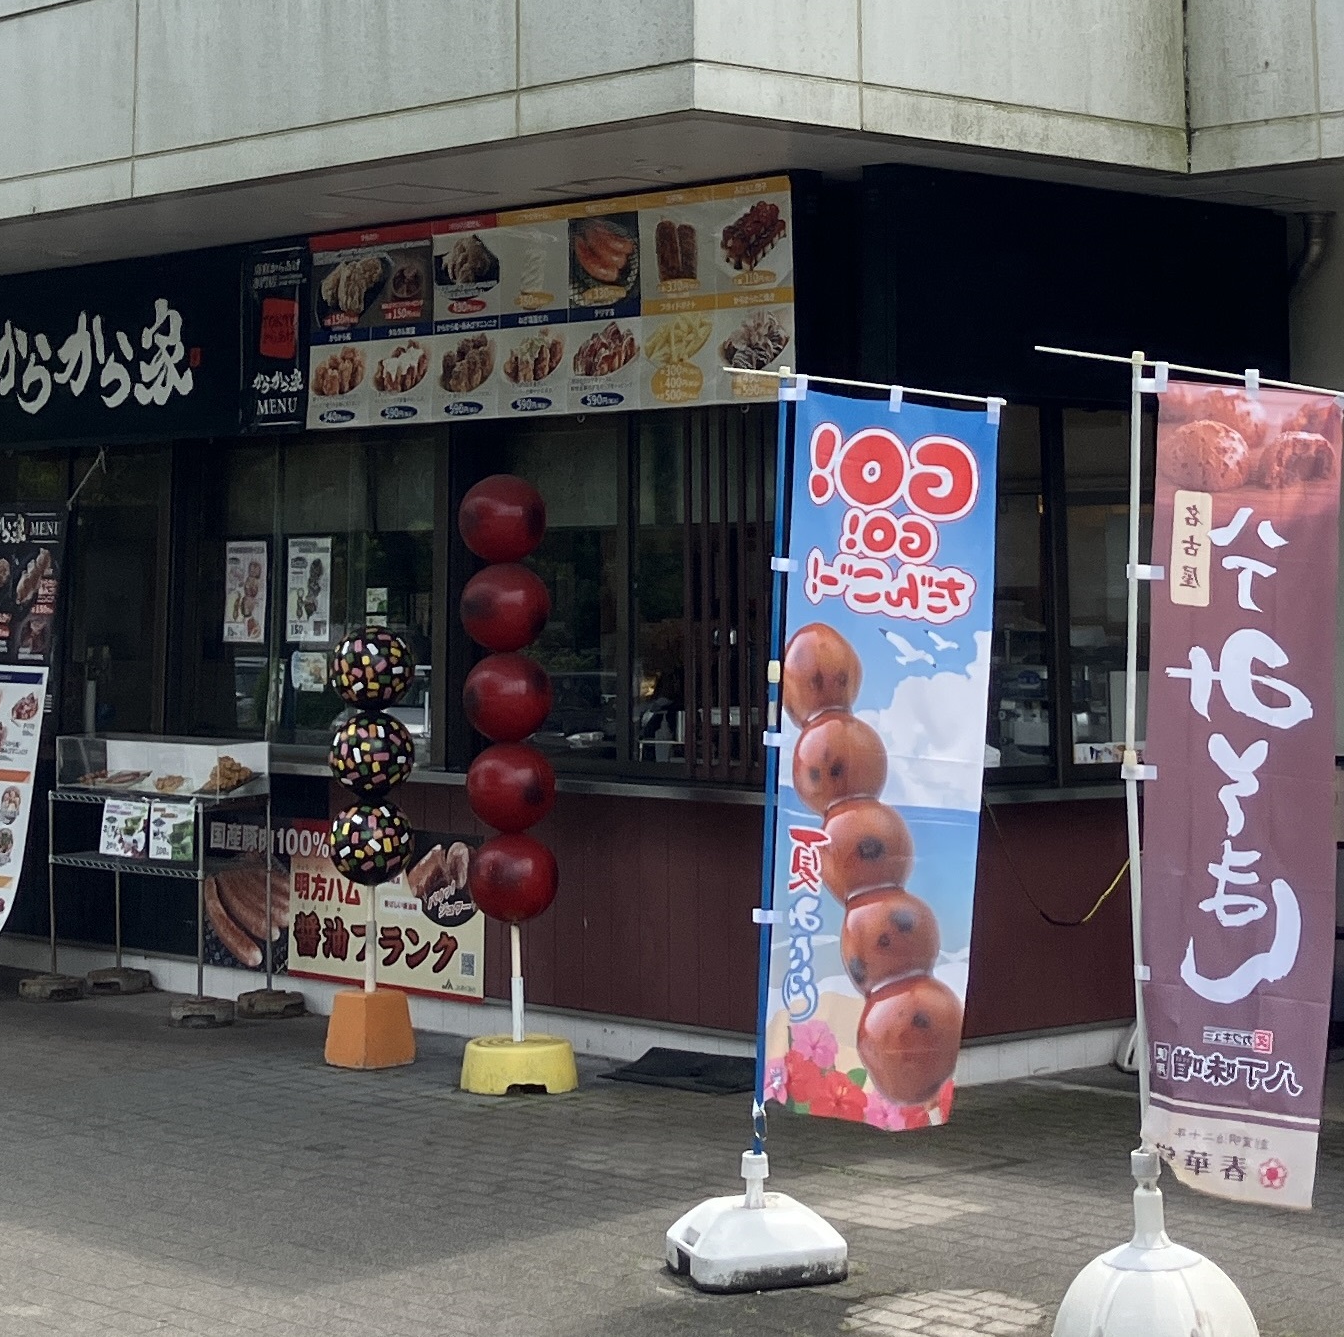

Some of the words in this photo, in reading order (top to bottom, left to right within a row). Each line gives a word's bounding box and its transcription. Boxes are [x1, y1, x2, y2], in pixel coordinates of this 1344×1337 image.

[252, 368, 304, 394] からから家
[257, 397, 298, 415] MENU
[210, 822, 330, 858] 国産豚肉100%
[294, 871, 361, 905] 明方ハム
